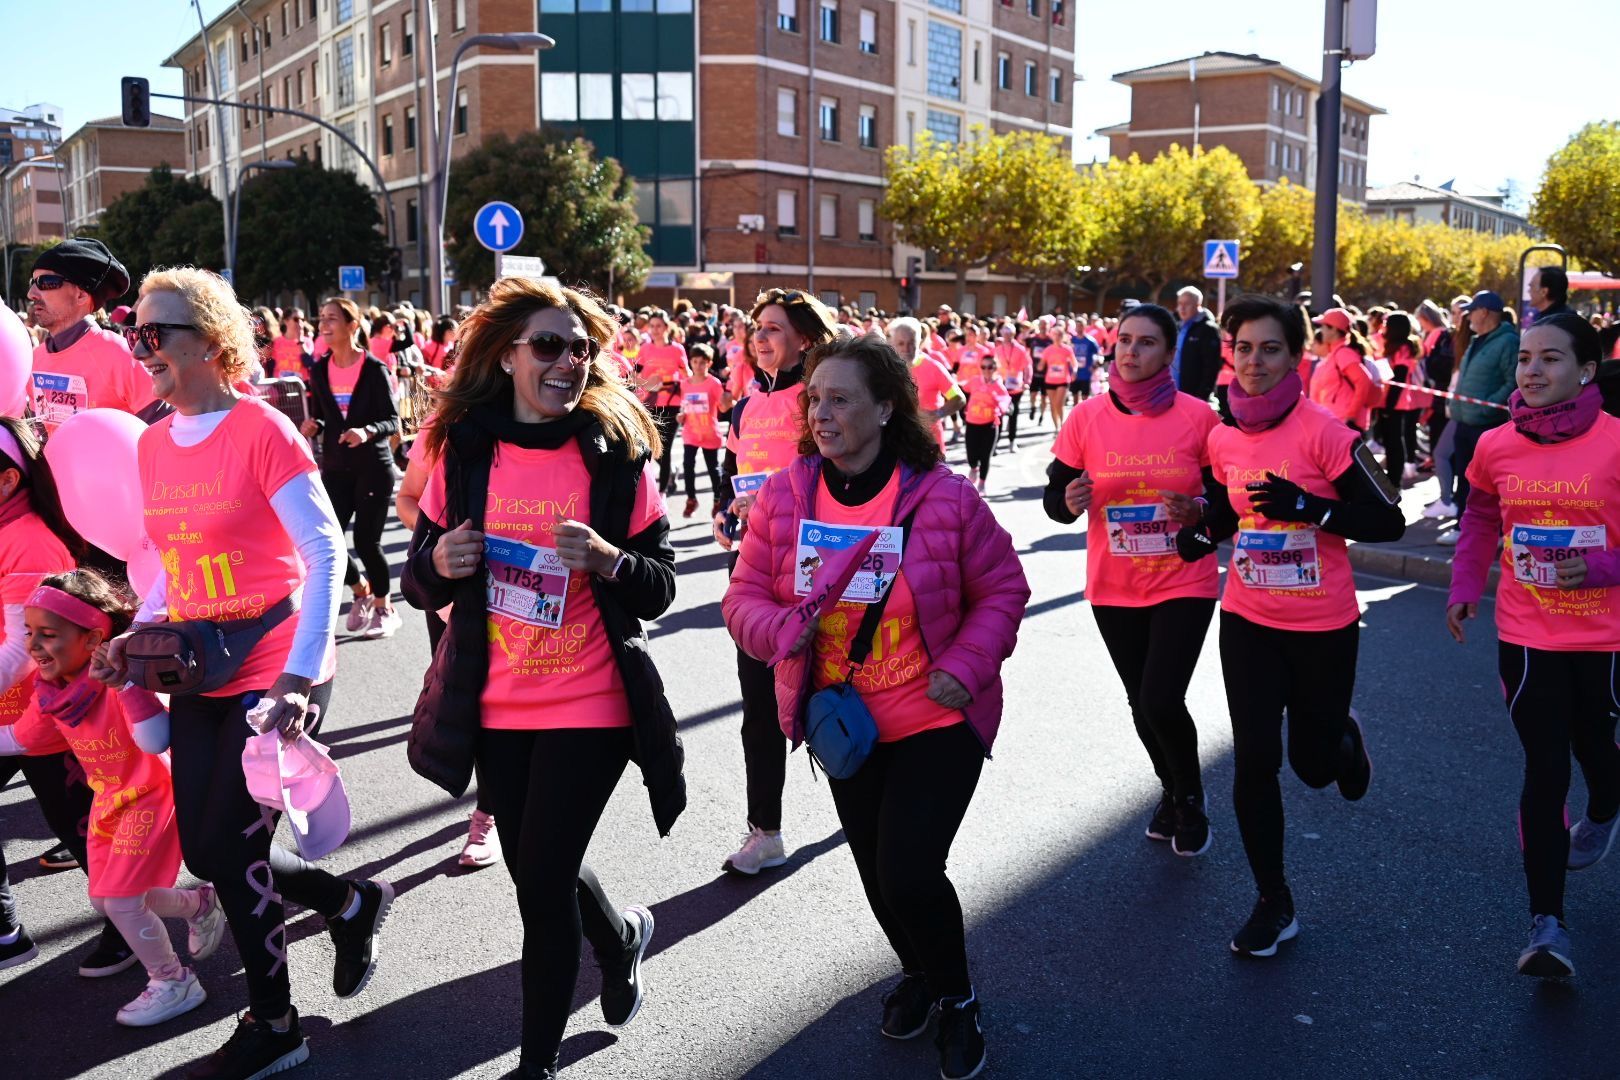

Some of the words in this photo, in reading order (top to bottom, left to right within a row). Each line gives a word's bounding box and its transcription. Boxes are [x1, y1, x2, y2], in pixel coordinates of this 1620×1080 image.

[52, 391, 77, 406] 2375
[1134, 520, 1168, 534] 3597
[167, 532, 203, 541] SUZUKI
[807, 528, 822, 542] hp
[861, 553, 884, 571] 26
[1261, 550, 1303, 565] 3596
[504, 566, 544, 592] 1752
[186, 594, 265, 619] Carrera
[1549, 608, 1610, 616] DRASANVI
[526, 640, 586, 657] Mujer
[512, 665, 584, 675] DRASANVI
[869, 663, 921, 691] Mujer
[119, 823, 152, 839] ujer
